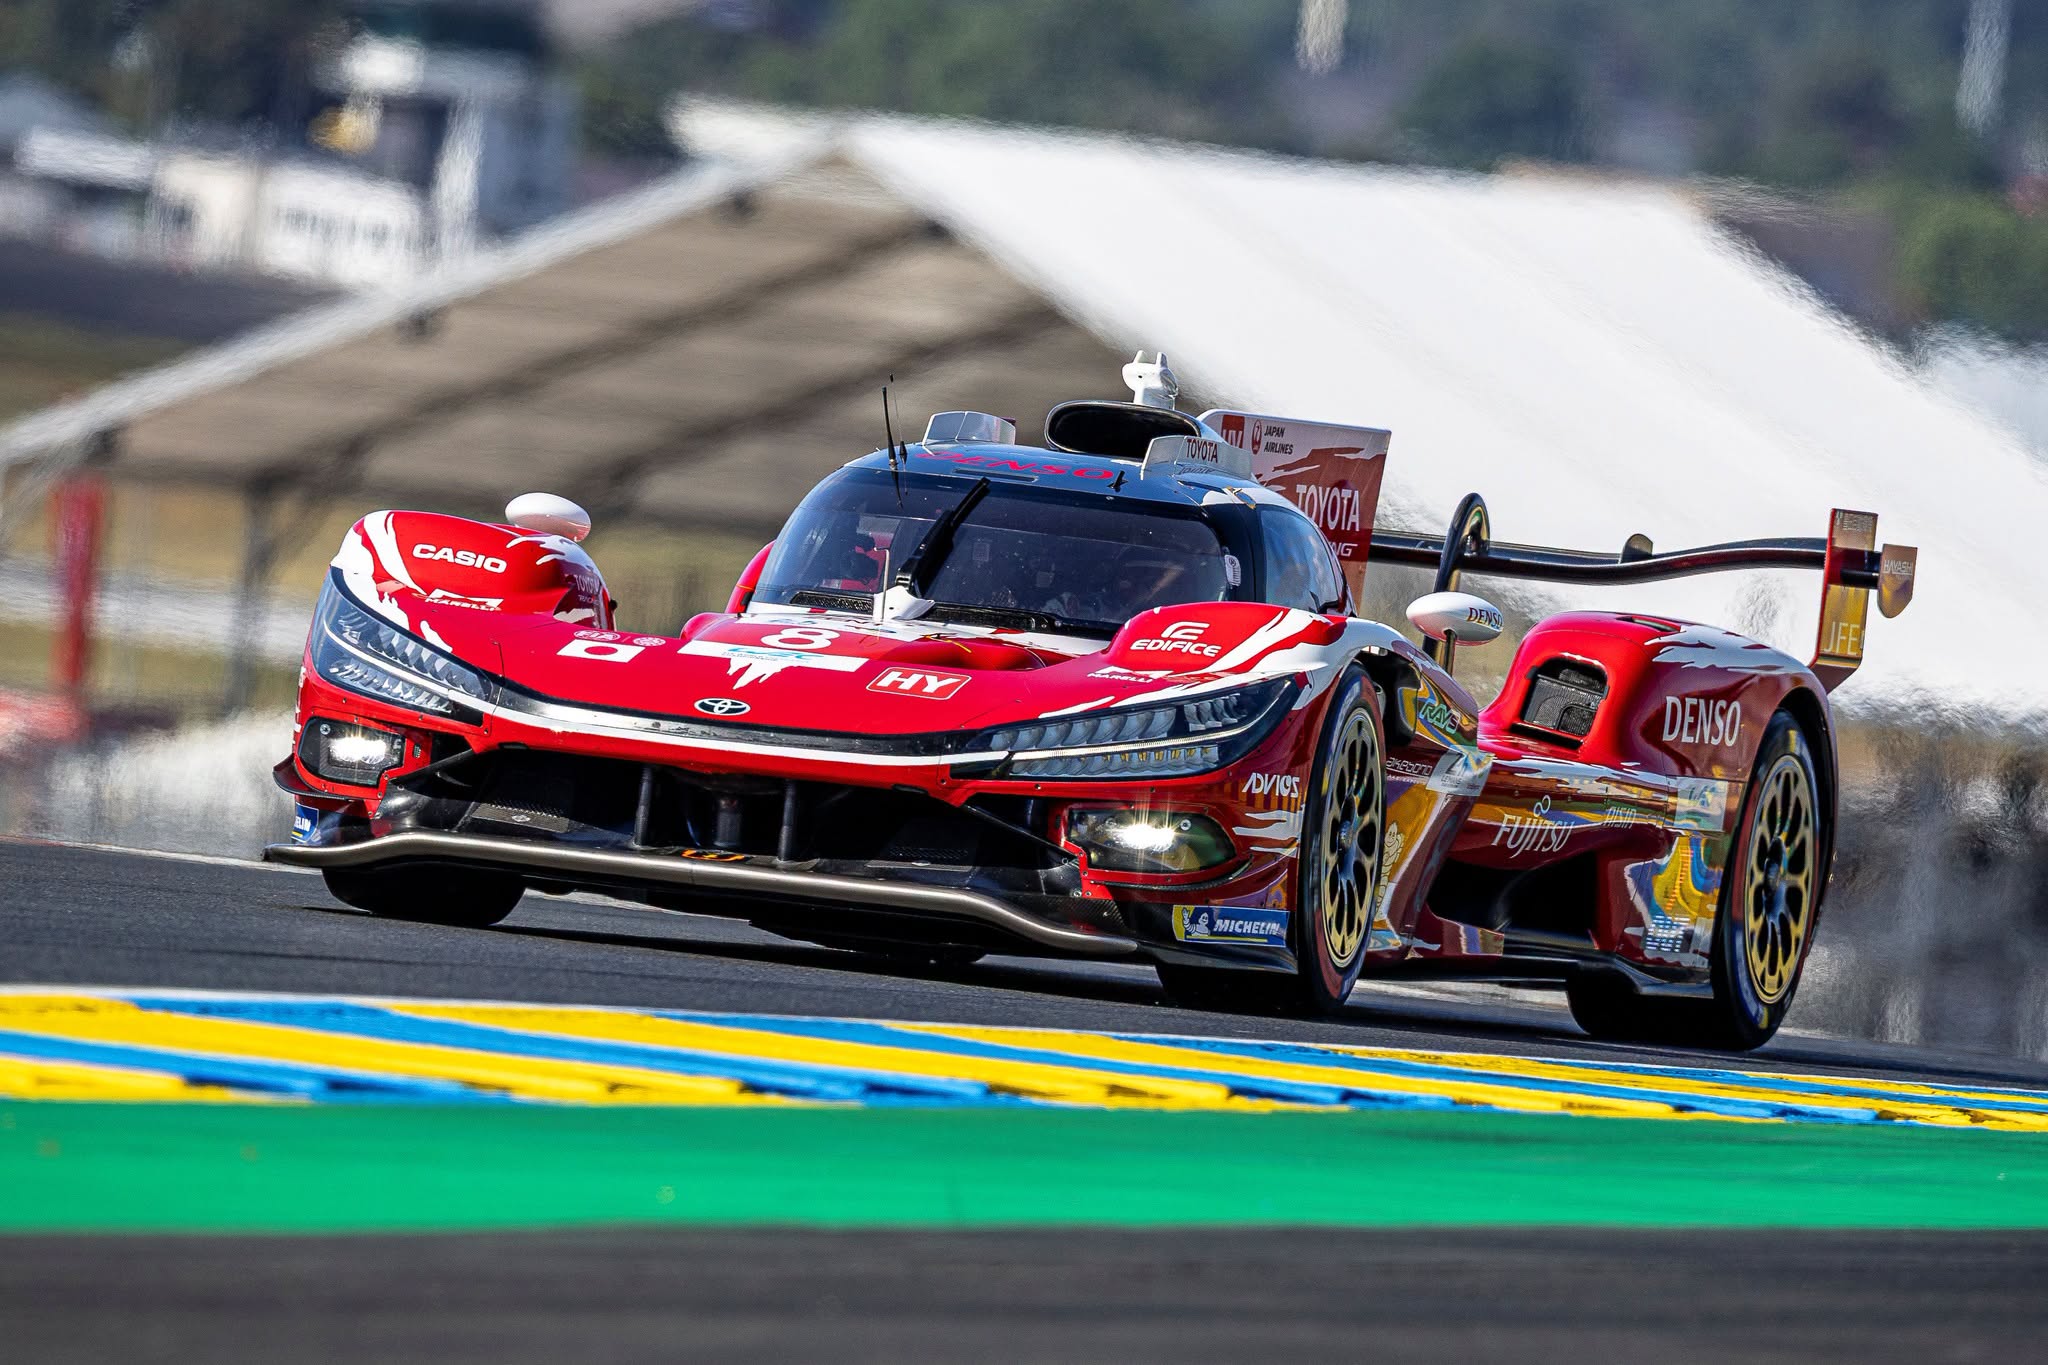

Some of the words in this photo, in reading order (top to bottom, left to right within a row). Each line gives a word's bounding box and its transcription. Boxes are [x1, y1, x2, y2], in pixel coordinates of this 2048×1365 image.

[1264, 425, 1285, 438] JAPAN
[1186, 438, 1219, 463] TOYOTA
[1263, 442, 1294, 455] AIRLINES
[916, 450, 1114, 480] DENSO
[1296, 484, 1360, 532] TOYOTA
[412, 543, 508, 574] CASIO
[1466, 606, 1503, 629] DENSO
[760, 627, 842, 651] 8
[1130, 638, 1222, 658] EDIFICE
[1822, 620, 1861, 656] JFE
[876, 670, 962, 694] HY
[1087, 672, 1153, 684] MARELLI
[1418, 699, 1461, 735] RAYS
[1661, 695, 1742, 748] DENSO
[1602, 806, 1637, 830] AISIN
[1491, 814, 1575, 859] FUJITSU
[1213, 918, 1281, 937] MICHELIN
